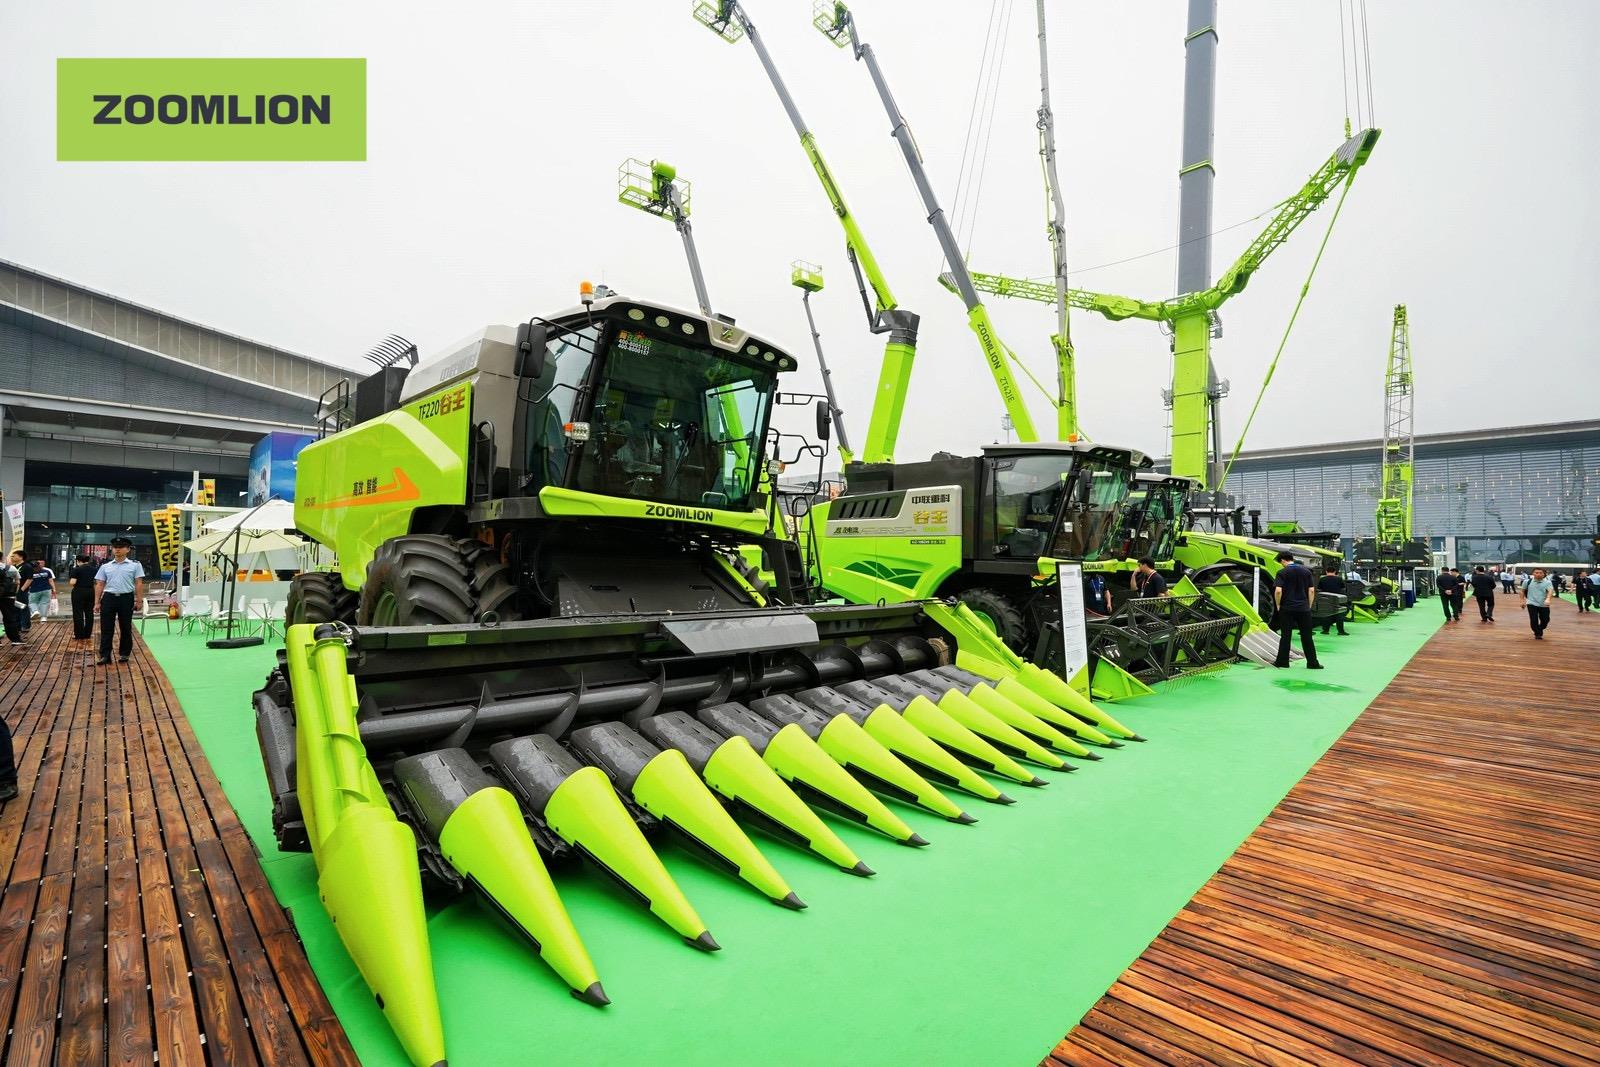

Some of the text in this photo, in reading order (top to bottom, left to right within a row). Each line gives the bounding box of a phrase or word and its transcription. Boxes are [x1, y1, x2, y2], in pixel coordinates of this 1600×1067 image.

[977, 321, 1002, 370] ZOOMLION
[911, 494, 950, 504] 中联重科
[645, 504, 714, 521] ZOOMLION
[913, 510, 948, 525] 谷王
